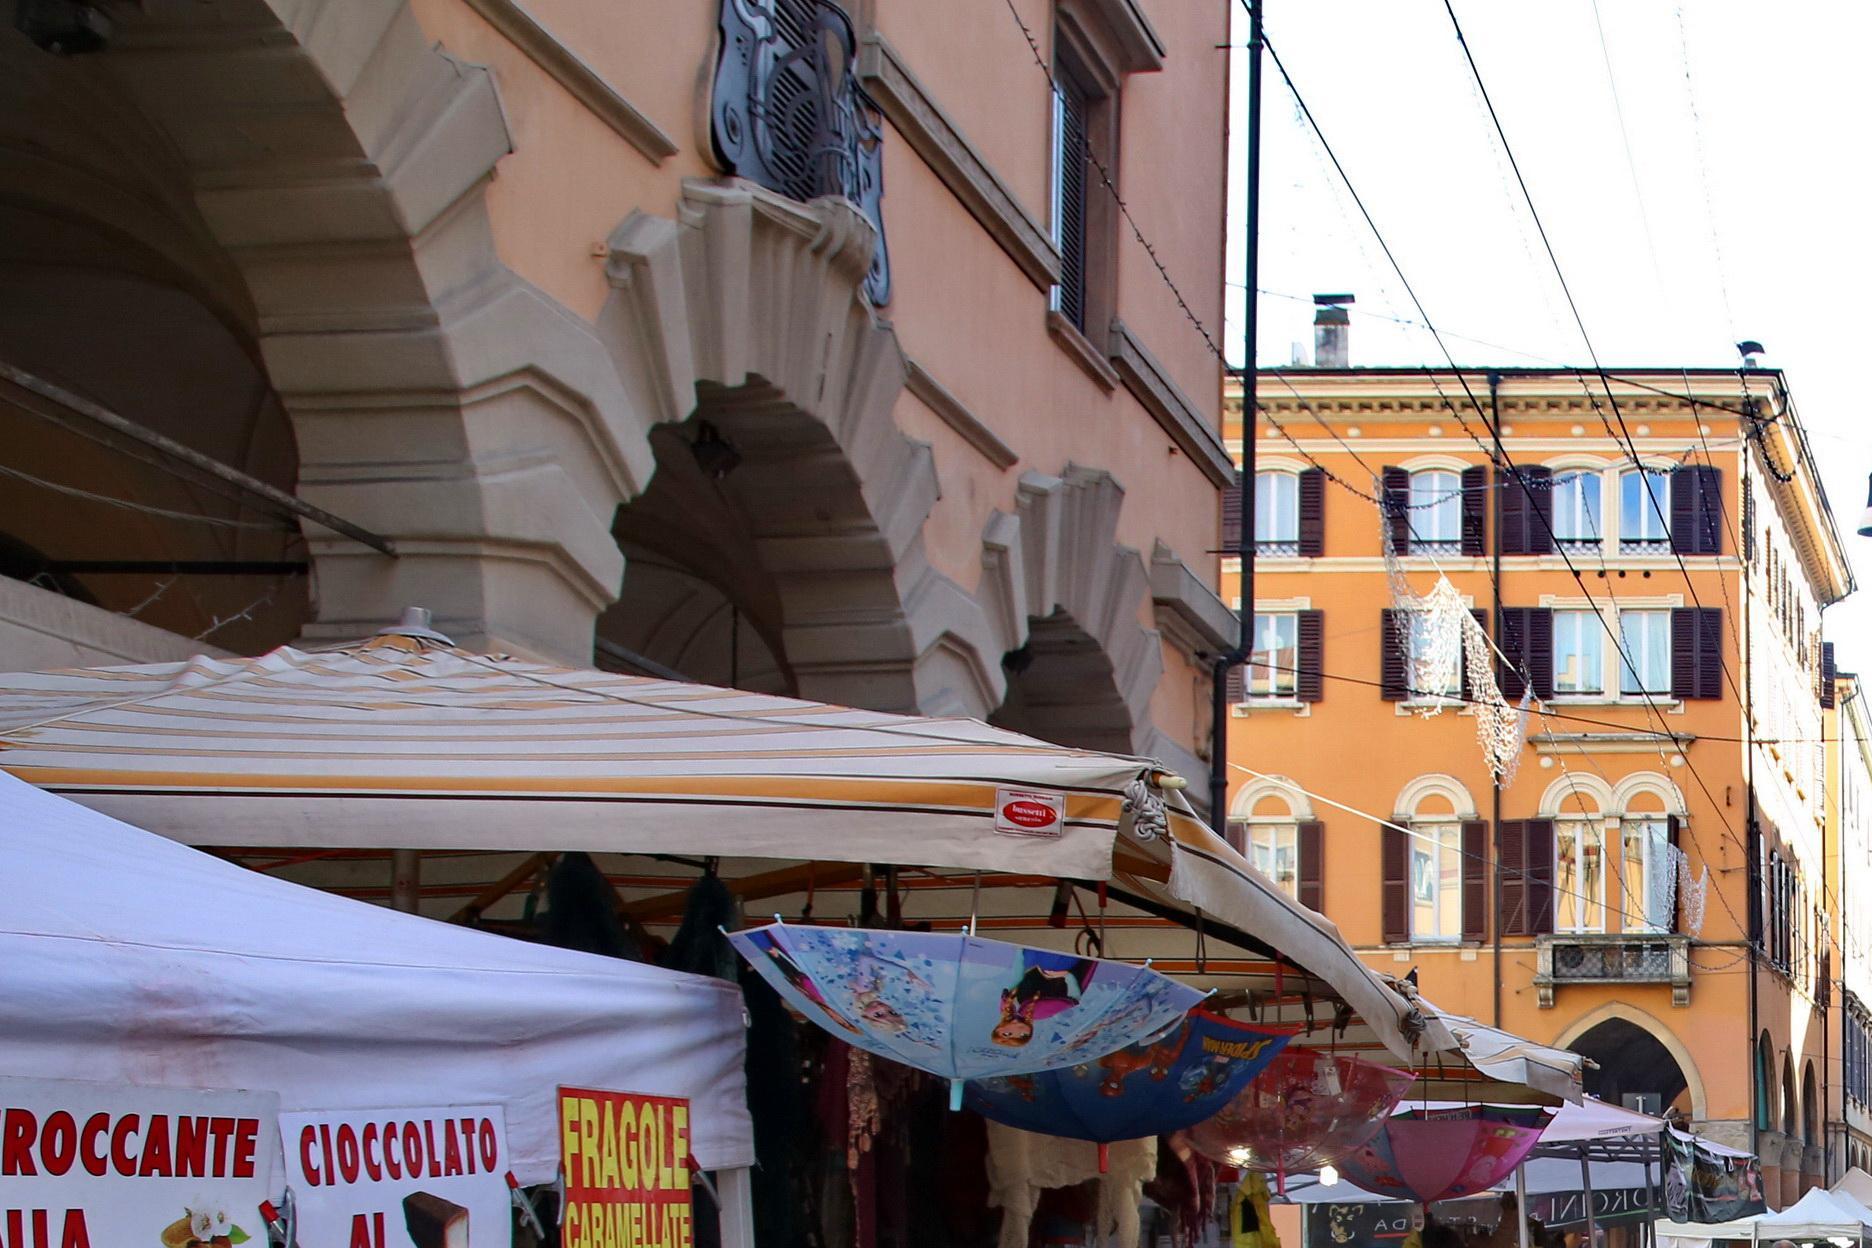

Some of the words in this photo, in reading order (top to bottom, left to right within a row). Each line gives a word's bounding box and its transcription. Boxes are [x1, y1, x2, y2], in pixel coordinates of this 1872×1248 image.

[0, 1108, 259, 1178] ROCCANTE
[300, 1117, 497, 1187] CIOCCOLATO
[563, 1097, 690, 1191] FRAGOLE
